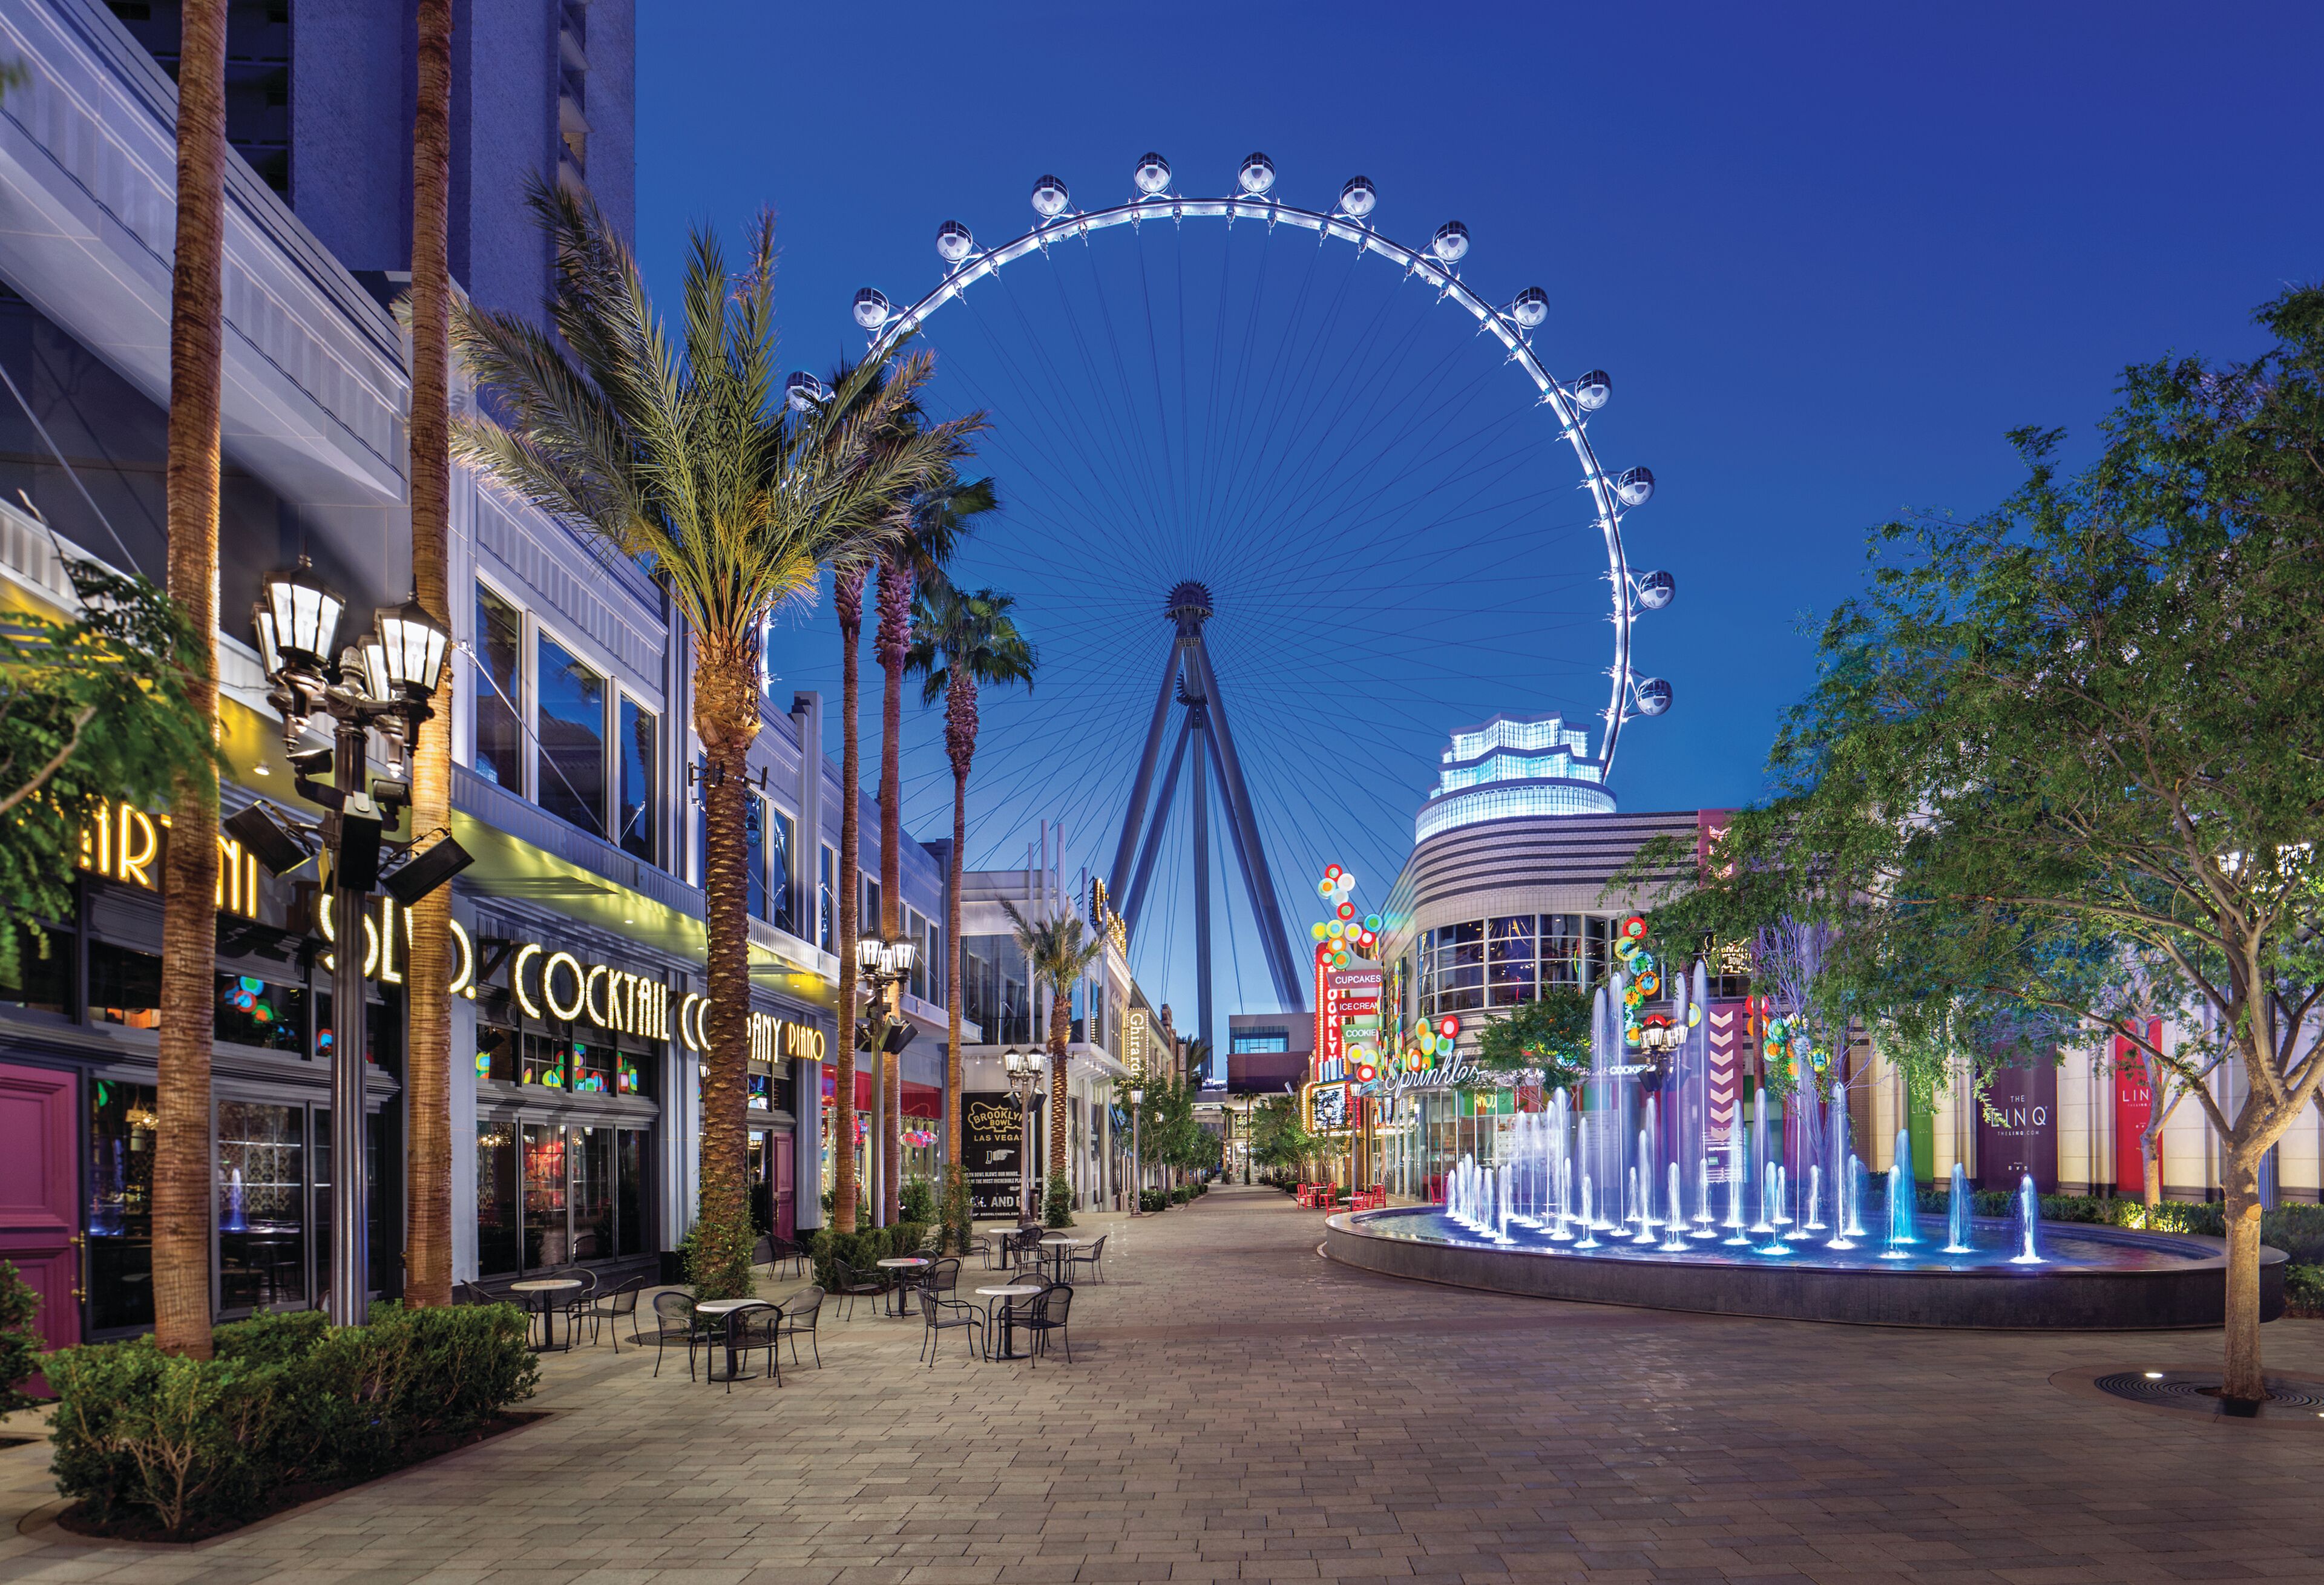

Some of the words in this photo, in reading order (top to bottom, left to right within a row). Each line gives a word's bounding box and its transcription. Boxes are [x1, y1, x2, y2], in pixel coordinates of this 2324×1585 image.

[17, 789, 258, 919] ARNI
[1728, 957, 1744, 965] BOWL
[1335, 974, 1381, 984] CUPCAKES
[515, 943, 670, 1041] COCKTAIL
[681, 993, 782, 1063] CANY
[788, 1021, 825, 1062] PIANO
[1345, 1029, 1377, 1037] COOKIE
[1130, 1013, 1144, 1080] Ghirarde
[1385, 1050, 1489, 1099] Sprinkles
[2123, 1089, 2148, 1102] LIN
[1991, 1106, 2046, 1127] LINQ
[991, 1196, 1014, 1207] AND
